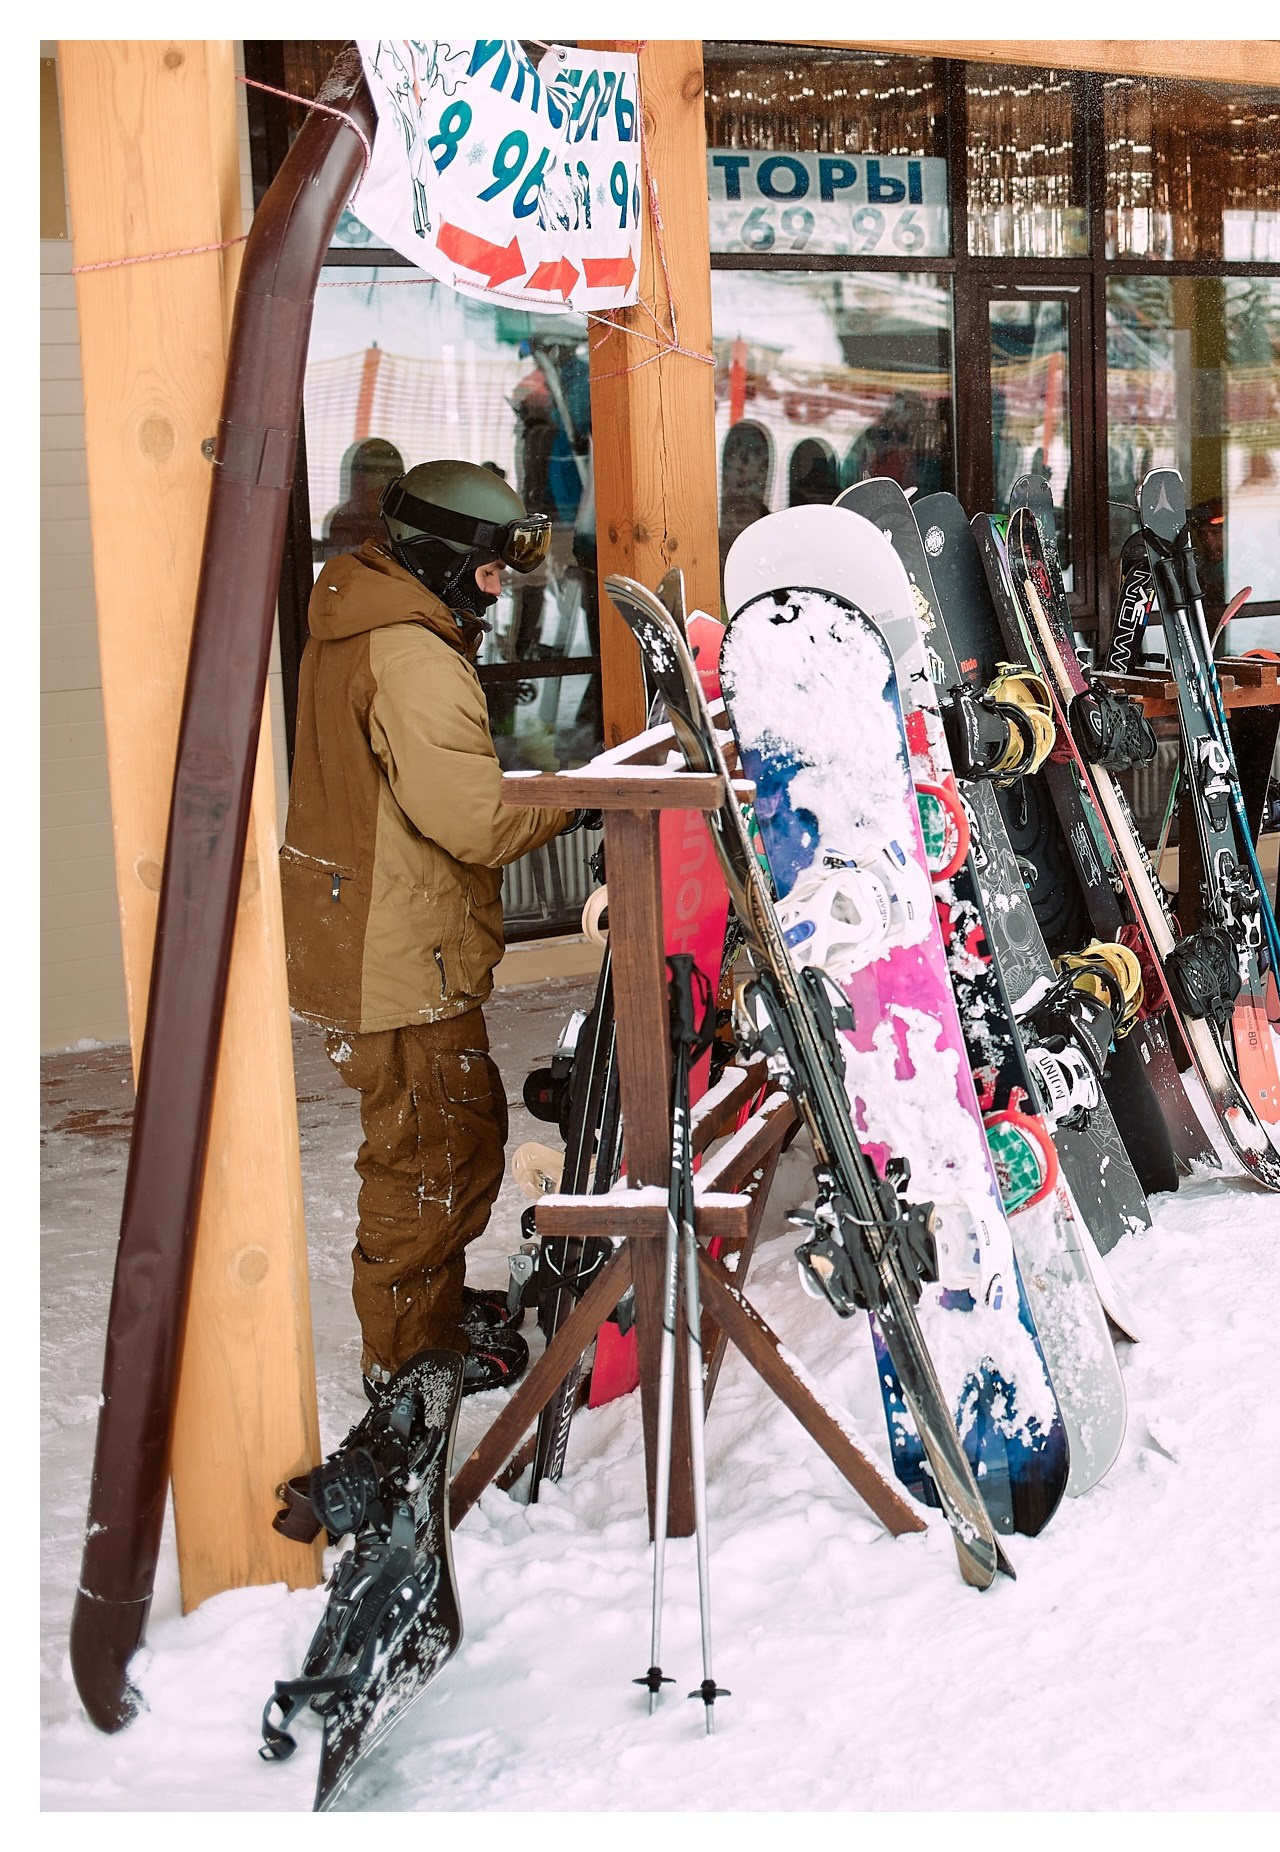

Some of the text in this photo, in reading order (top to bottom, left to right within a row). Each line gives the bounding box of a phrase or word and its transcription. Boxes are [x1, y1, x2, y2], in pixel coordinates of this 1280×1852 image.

[428, 100, 472, 172] 8
[708, 155, 923, 204] ТОРЫ
[740, 206, 925, 251] 69 96
[1248, 1031, 1258, 1046] 80
[672, 1107, 685, 1171] LEKI
